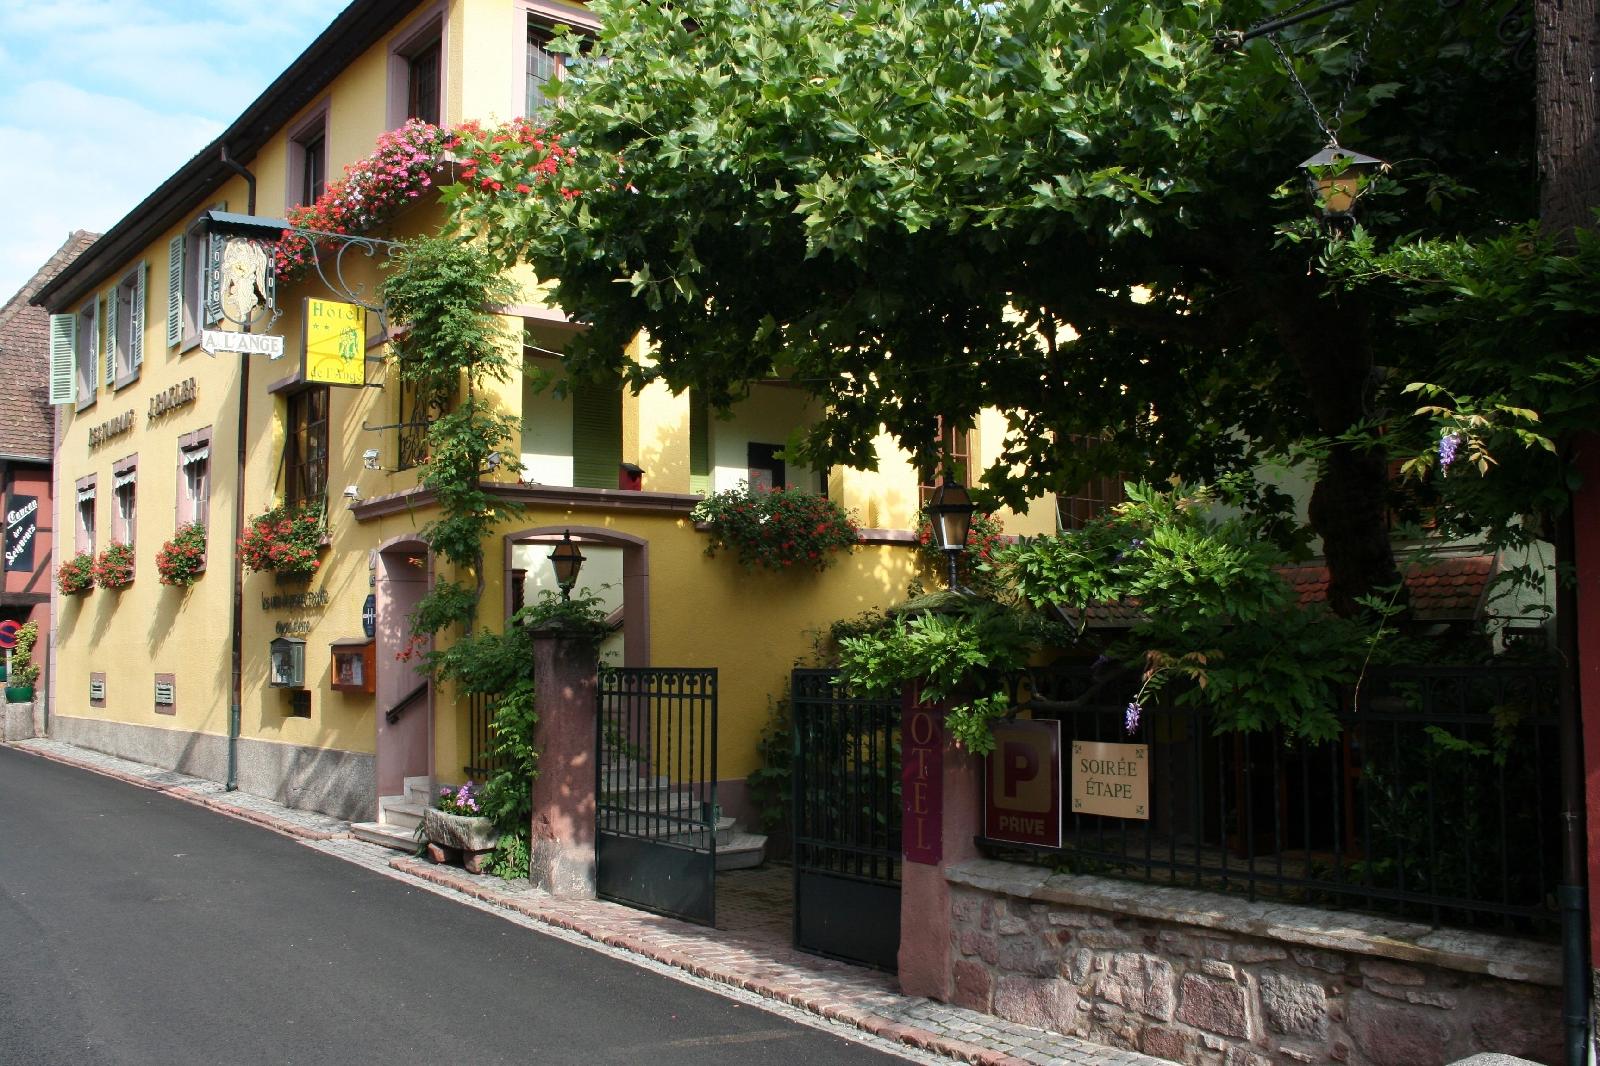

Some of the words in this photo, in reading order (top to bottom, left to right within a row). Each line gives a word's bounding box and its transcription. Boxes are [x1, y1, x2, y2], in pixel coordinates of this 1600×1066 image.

[313, 302, 361, 321] Hôtel
[224, 335, 280, 353] L'ANGE
[1004, 741, 1039, 798] P
[1080, 756, 1138, 777] SOIRÉE
[1086, 777, 1133, 799] ÉTAPE
[1000, 815, 1046, 836] PRIVE
